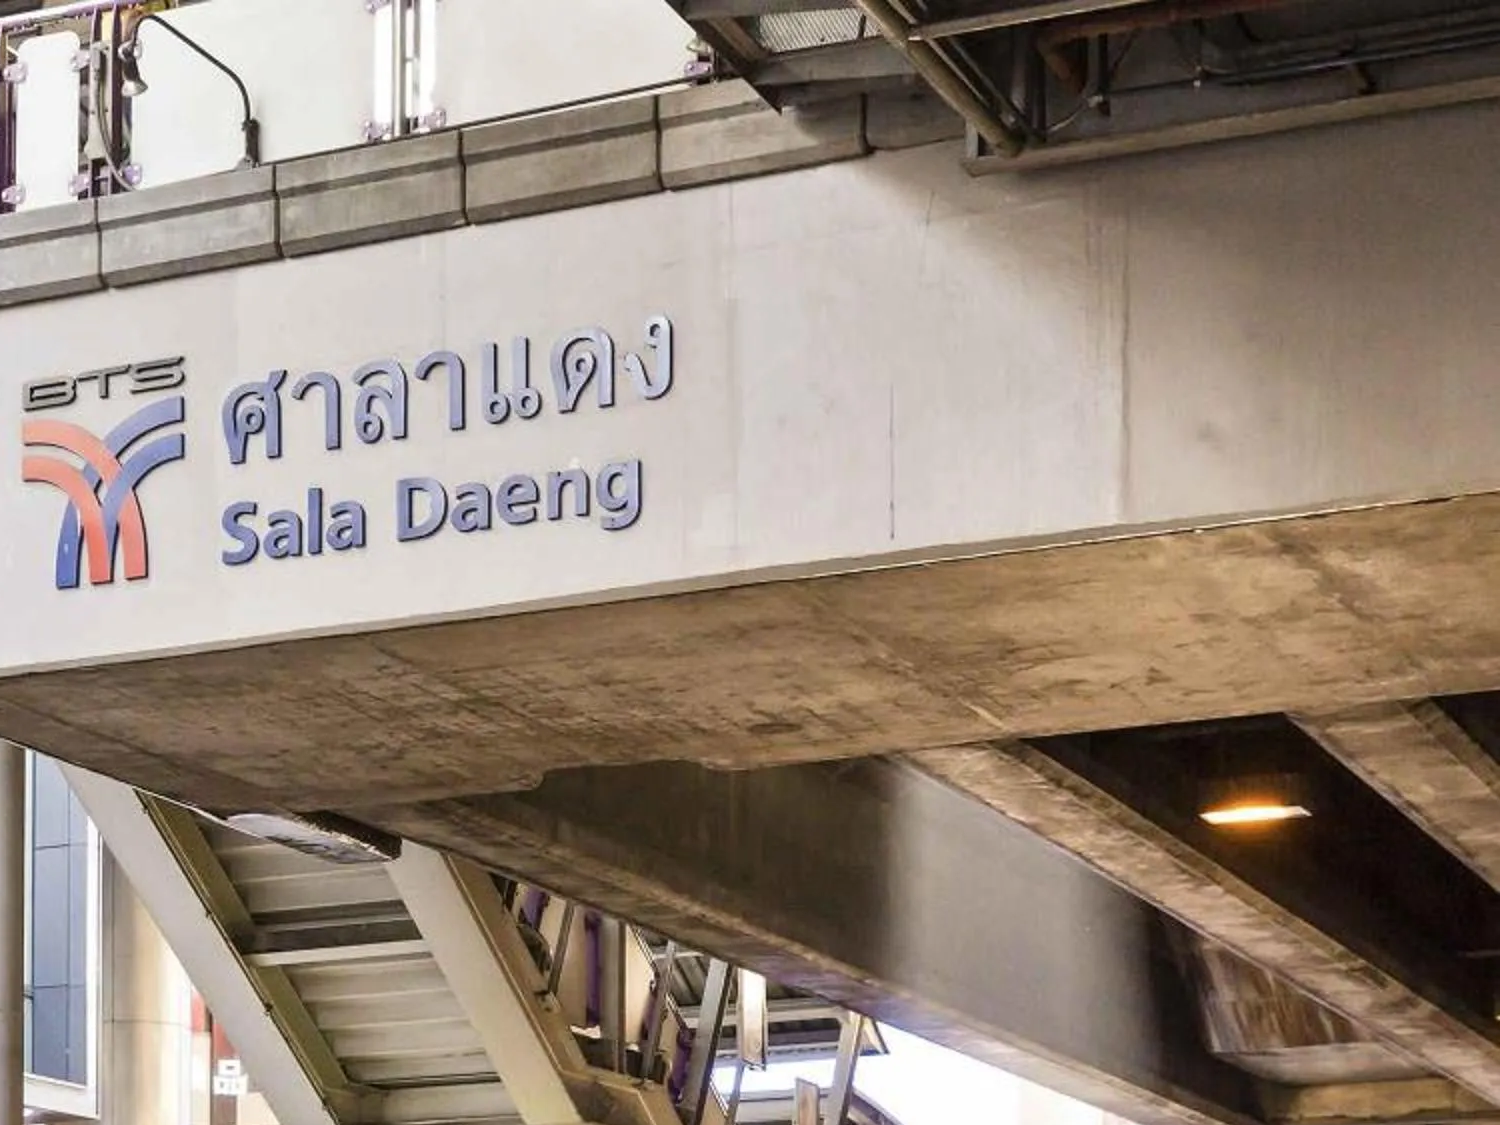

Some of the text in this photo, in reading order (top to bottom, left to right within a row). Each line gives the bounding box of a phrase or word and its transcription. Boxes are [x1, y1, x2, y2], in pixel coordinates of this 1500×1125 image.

[22, 355, 186, 412] BTS
[221, 314, 675, 465] ศาลาแดง
[221, 458, 643, 566] Sala Daeng
